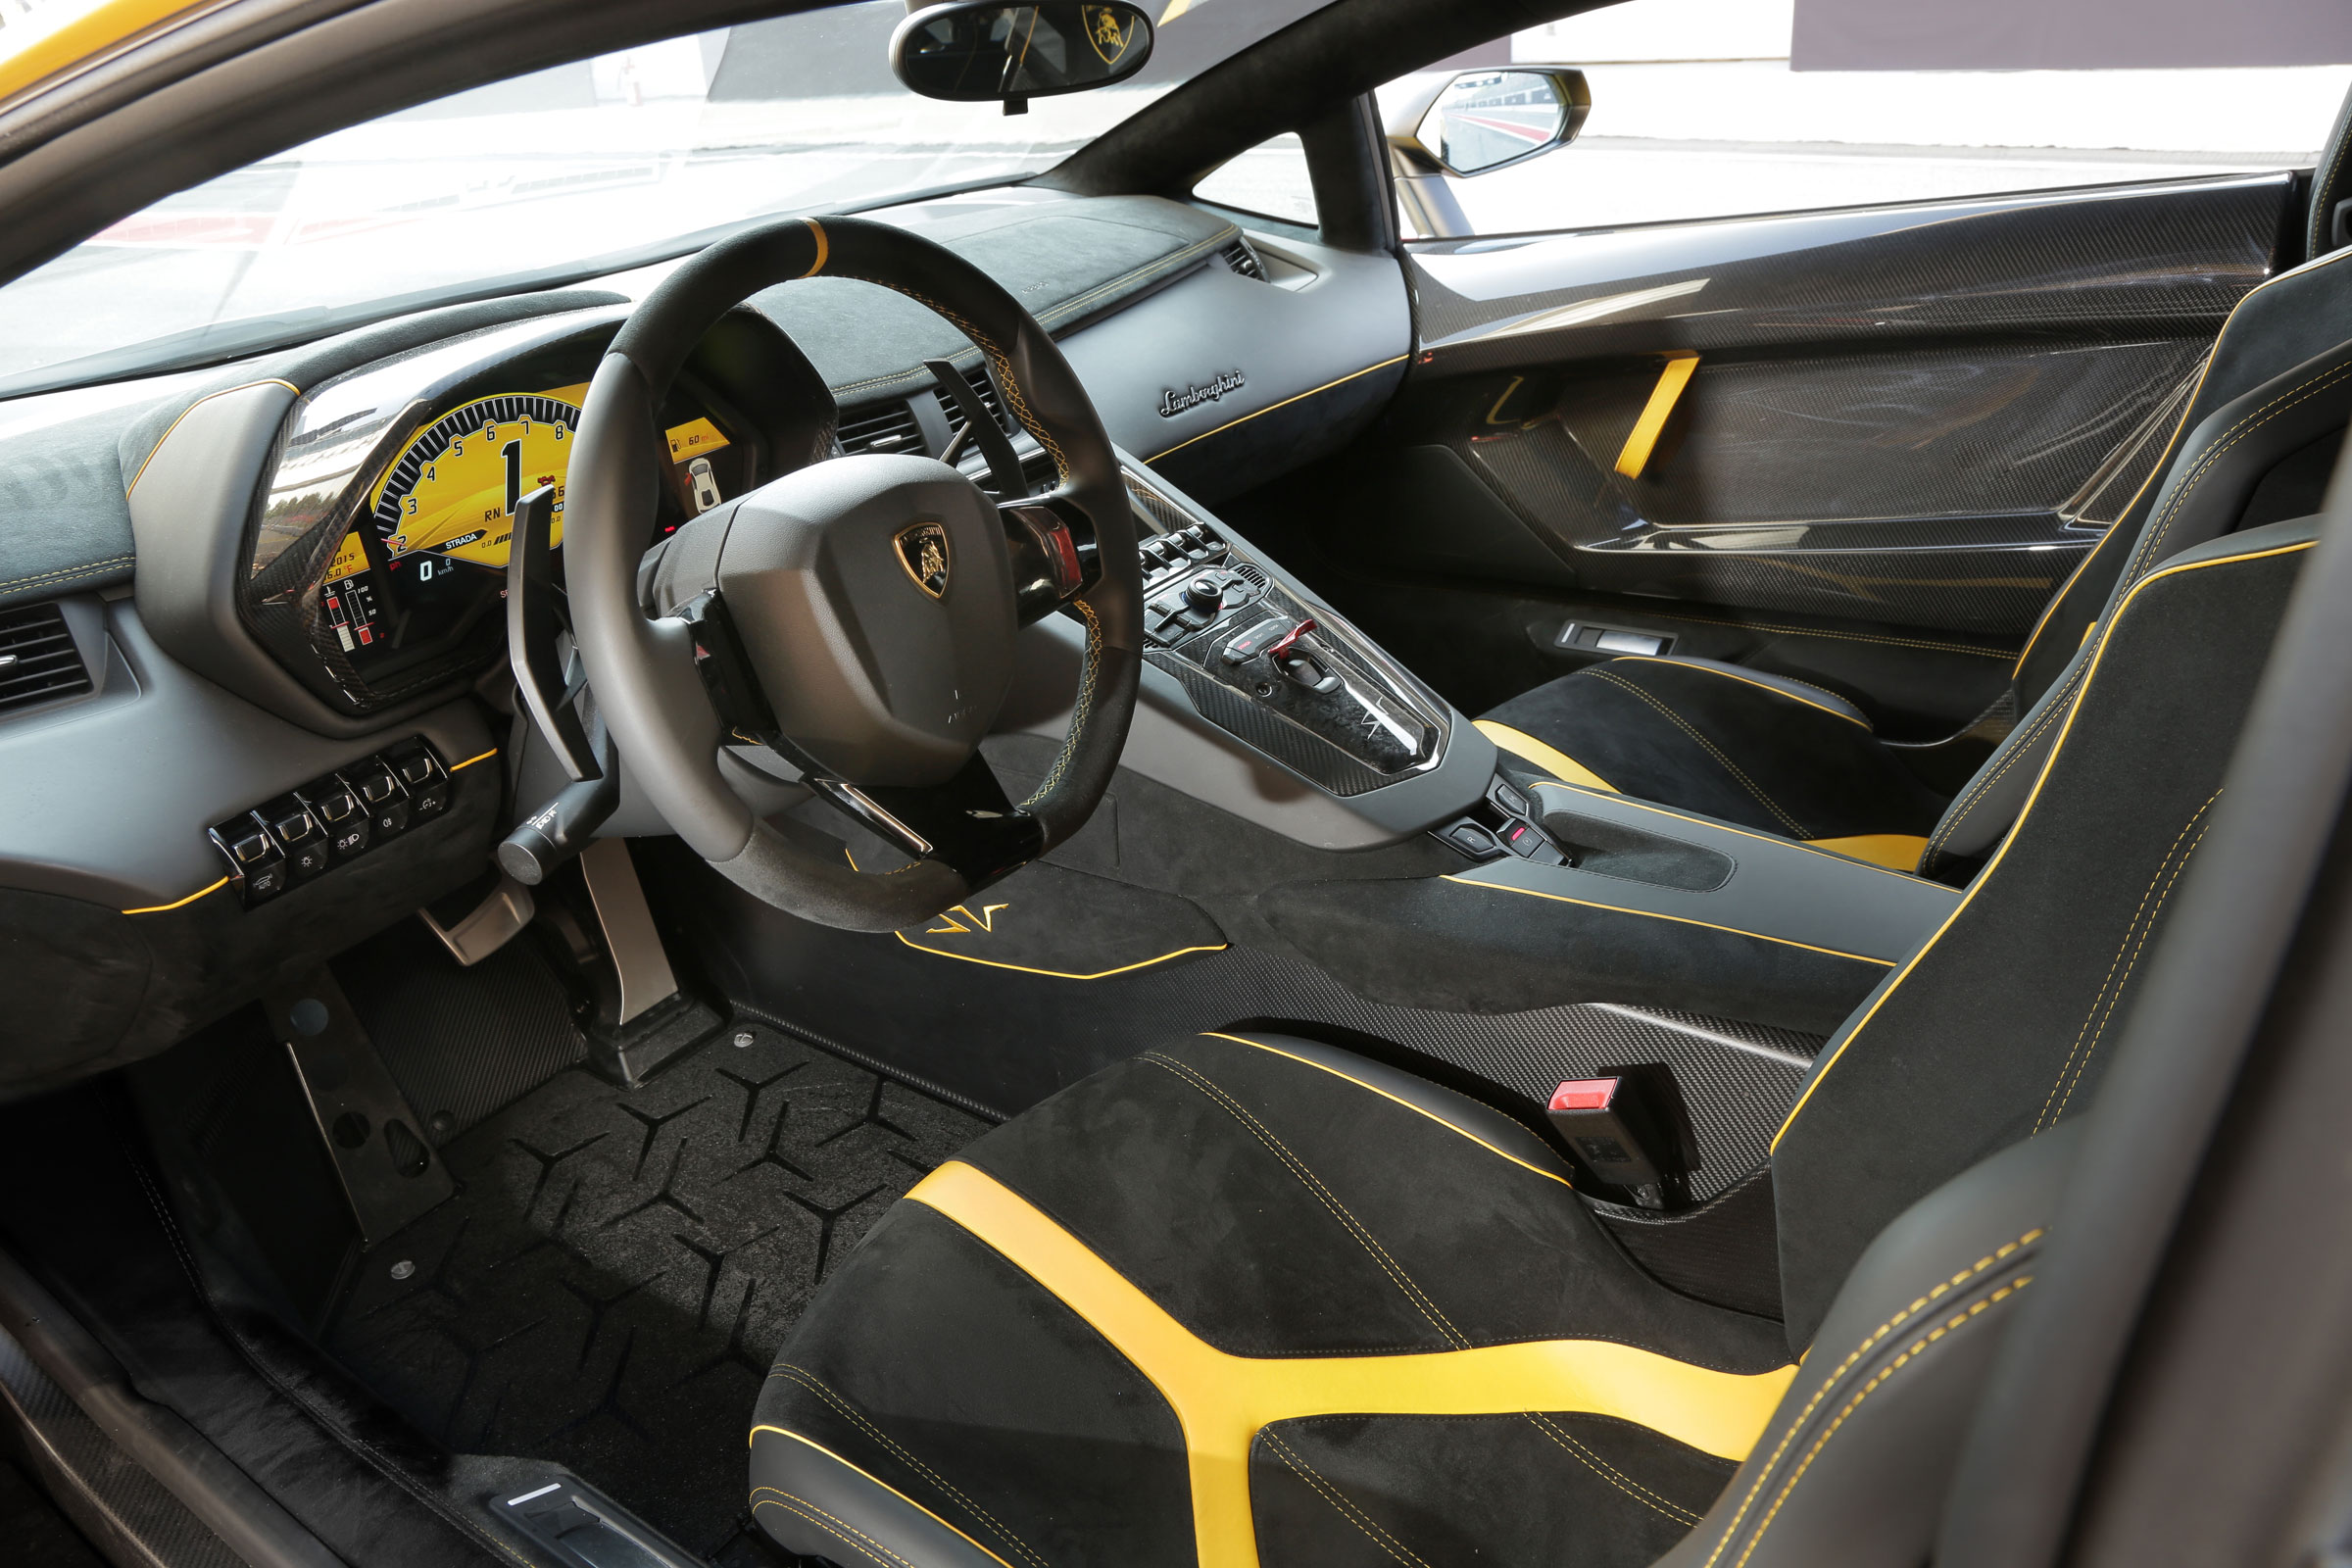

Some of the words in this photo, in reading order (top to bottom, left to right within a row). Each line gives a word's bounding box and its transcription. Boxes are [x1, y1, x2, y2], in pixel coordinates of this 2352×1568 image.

[1159, 369, 1246, 416] Lamborghini
[486, 425, 496, 441] 6
[520, 420, 529, 434] 7
[555, 425, 564, 440] 8
[689, 435, 700, 445] 60
[454, 441, 464, 457] 5
[426, 466, 436, 481] 4
[500, 439, 521, 516] 1
[407, 498, 417, 514] 3
[396, 535, 407, 552] 2
[445, 532, 478, 550] STRADA
[445, 558, 452, 566] 0
[419, 560, 432, 581] 0
[437, 565, 455, 576] km/h
[357, 585, 368, 594] 100
